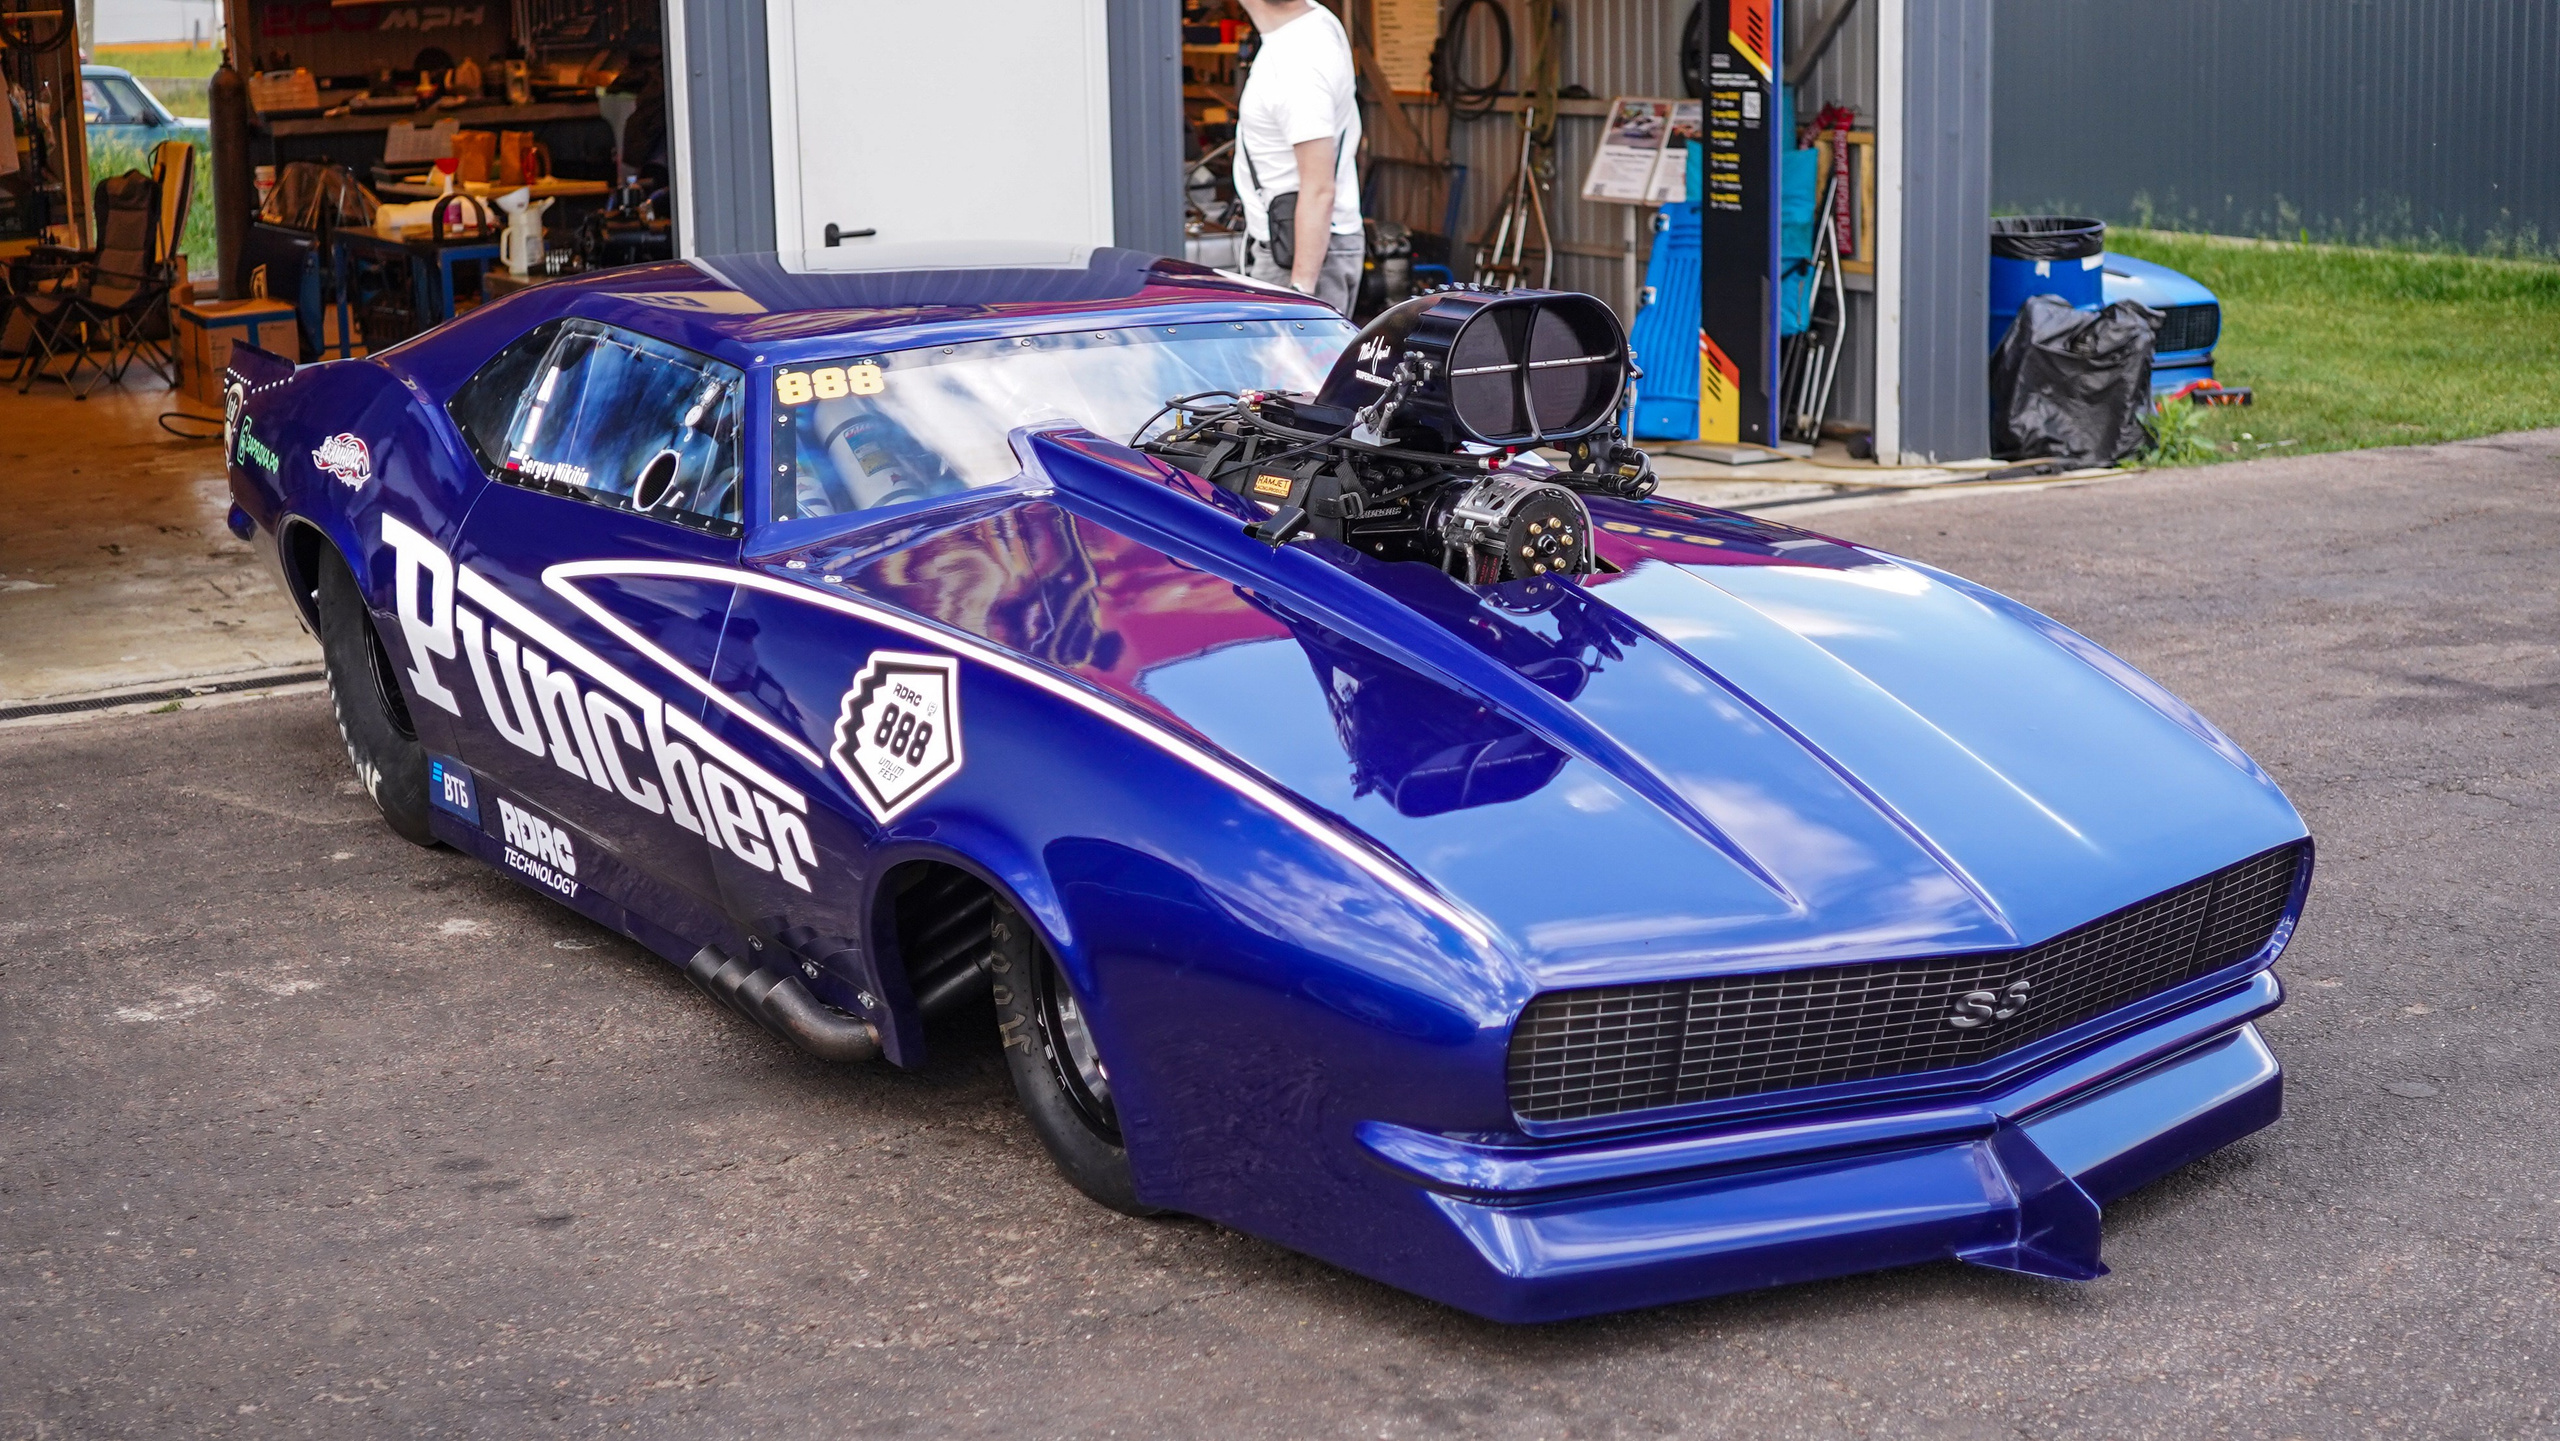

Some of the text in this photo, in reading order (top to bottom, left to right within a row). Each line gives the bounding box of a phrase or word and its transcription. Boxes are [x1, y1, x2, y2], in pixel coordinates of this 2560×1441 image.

[380, 6, 485, 32] MPH
[776, 364, 885, 405] 888
[519, 454, 590, 487] Sergey Nikitin
[1258, 474, 1290, 489] RAMJET
[382, 513, 818, 892] Puncher
[893, 682, 923, 707] RDRC
[874, 702, 933, 768] 888
[443, 772, 469, 809] ВТБ
[878, 768, 899, 783] FEST
[497, 797, 577, 877] RDRC
[504, 846, 578, 898] TECHNOLOGY
[1950, 980, 2031, 1028] SS
